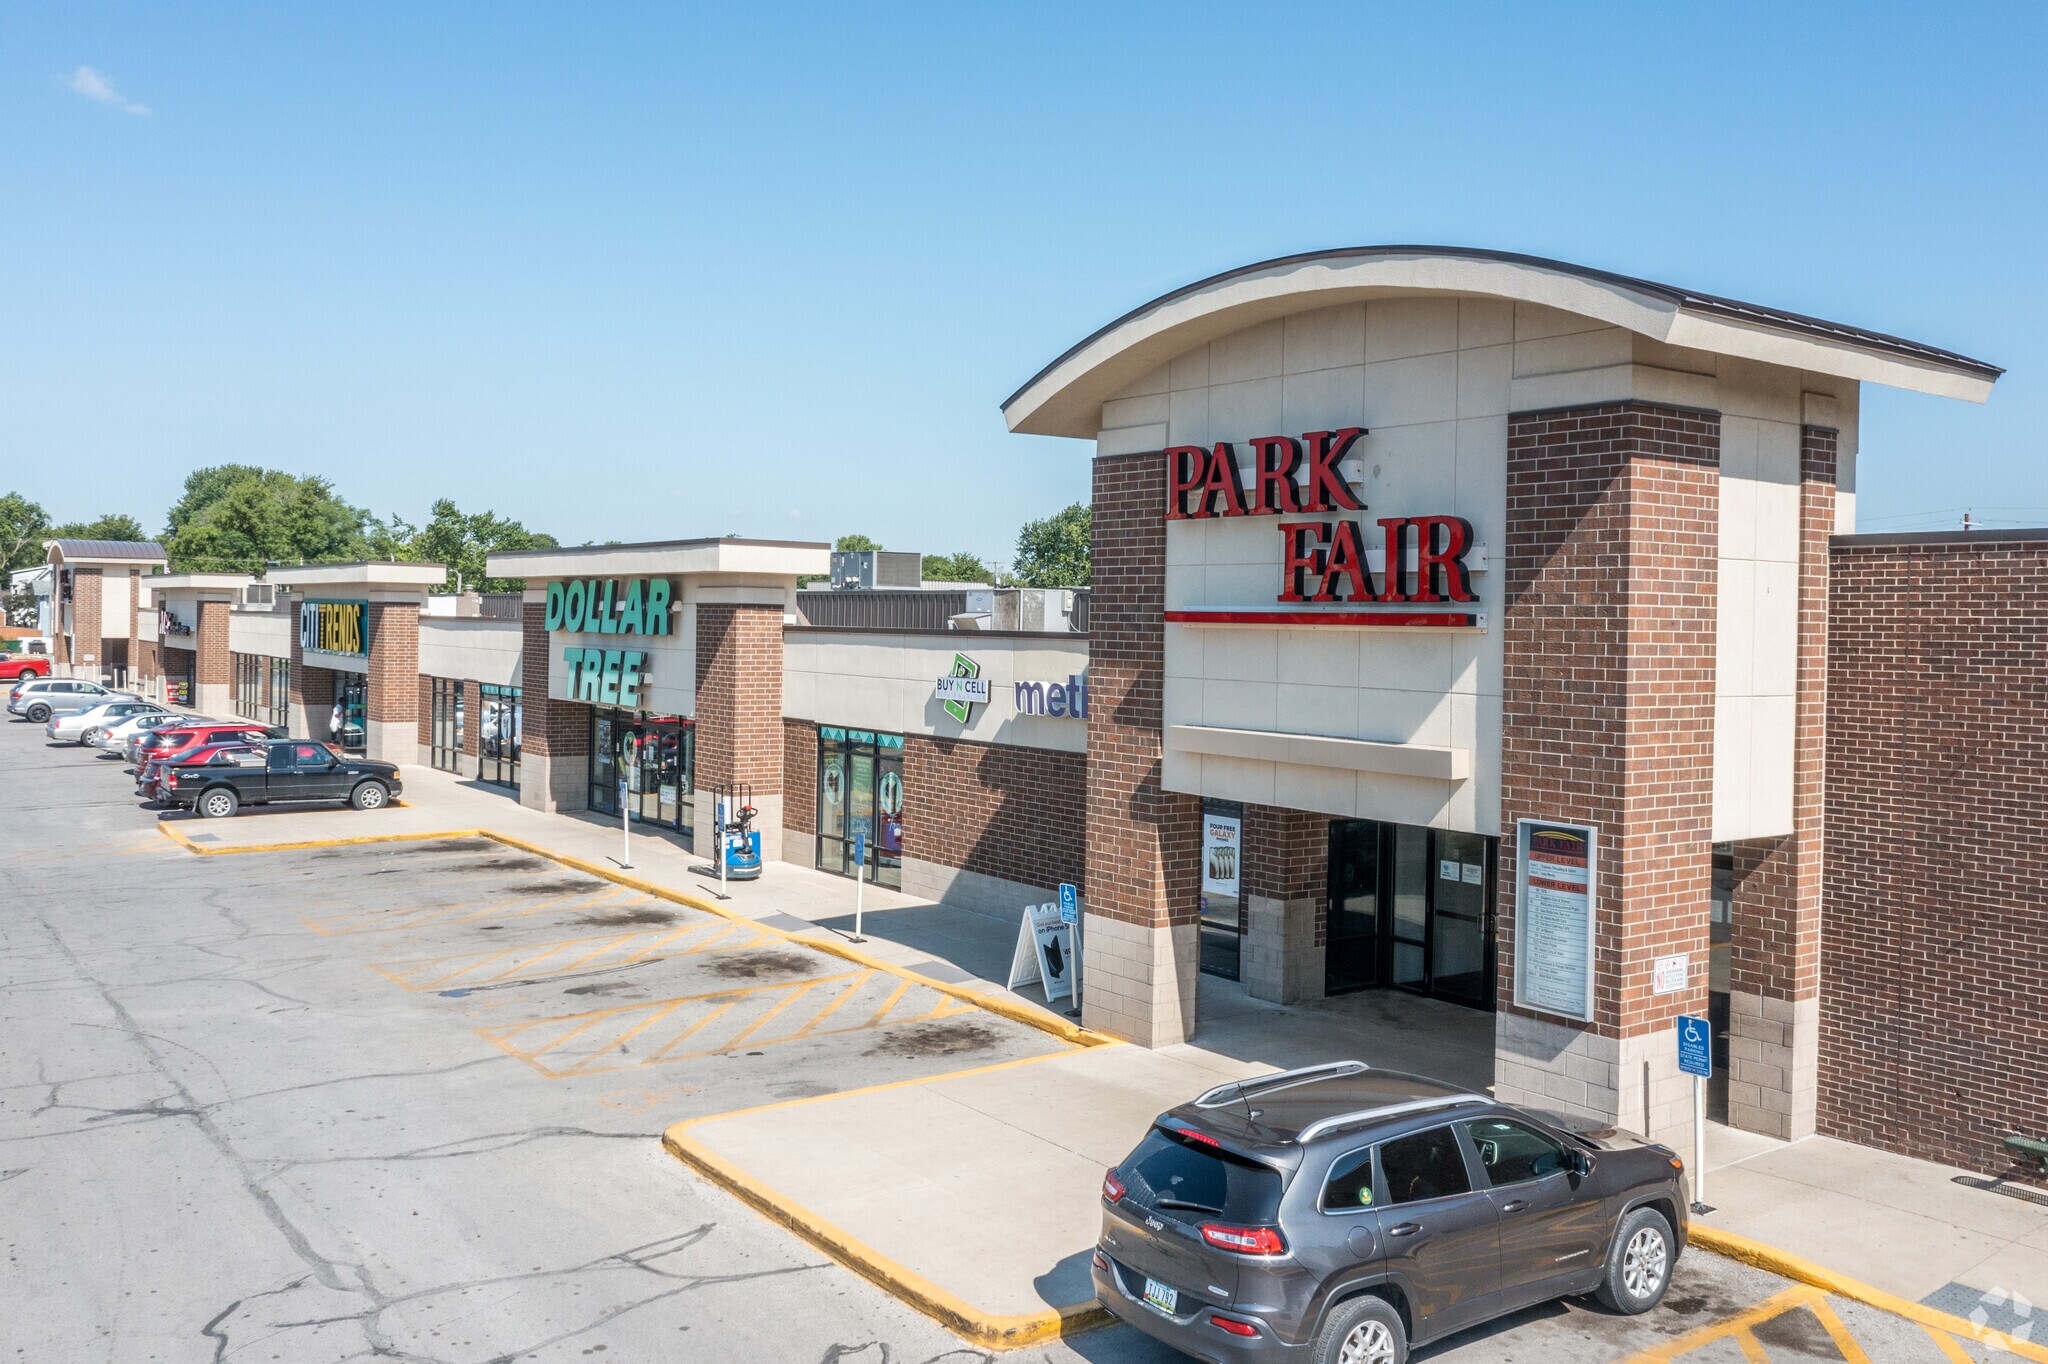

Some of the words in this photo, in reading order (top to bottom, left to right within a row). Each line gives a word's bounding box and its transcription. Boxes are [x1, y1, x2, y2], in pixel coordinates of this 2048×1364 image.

[1164, 426, 1369, 520] PARK
[1277, 515, 1480, 603] FAIR
[544, 578, 673, 636] DOLLAR
[301, 602, 319, 649] CITI
[319, 603, 360, 655] TRENDS
[564, 647, 646, 707] TREE
[937, 678, 954, 692] BUY
[956, 680, 963, 692] N
[964, 681, 986, 694] CELL
[1209, 823, 1223, 831] FOUR
[1223, 825, 1236, 833] FREE
[1209, 829, 1236, 839] GALAXY
[1533, 836, 1556, 849] PARK
[1560, 840, 1585, 851] FAIR
[1534, 853, 1555, 862] UPPER
[1556, 856, 1580, 866] LEVEL
[1533, 878, 1556, 889] LOWER
[1557, 882, 1580, 892] LEVEL
[1046, 924, 1065, 933] iPhone
[1656, 971, 1665, 989] NO
[1682, 1041, 1705, 1051] DISABLED
[1684, 1047, 1704, 1056] PARKING
[1683, 1059, 1705, 1068] REQUIRED
[1693, 1056, 1708, 1064] PERMIT
[1145, 1216, 1164, 1231] Jeep
[1161, 1289, 1174, 1305] 792
